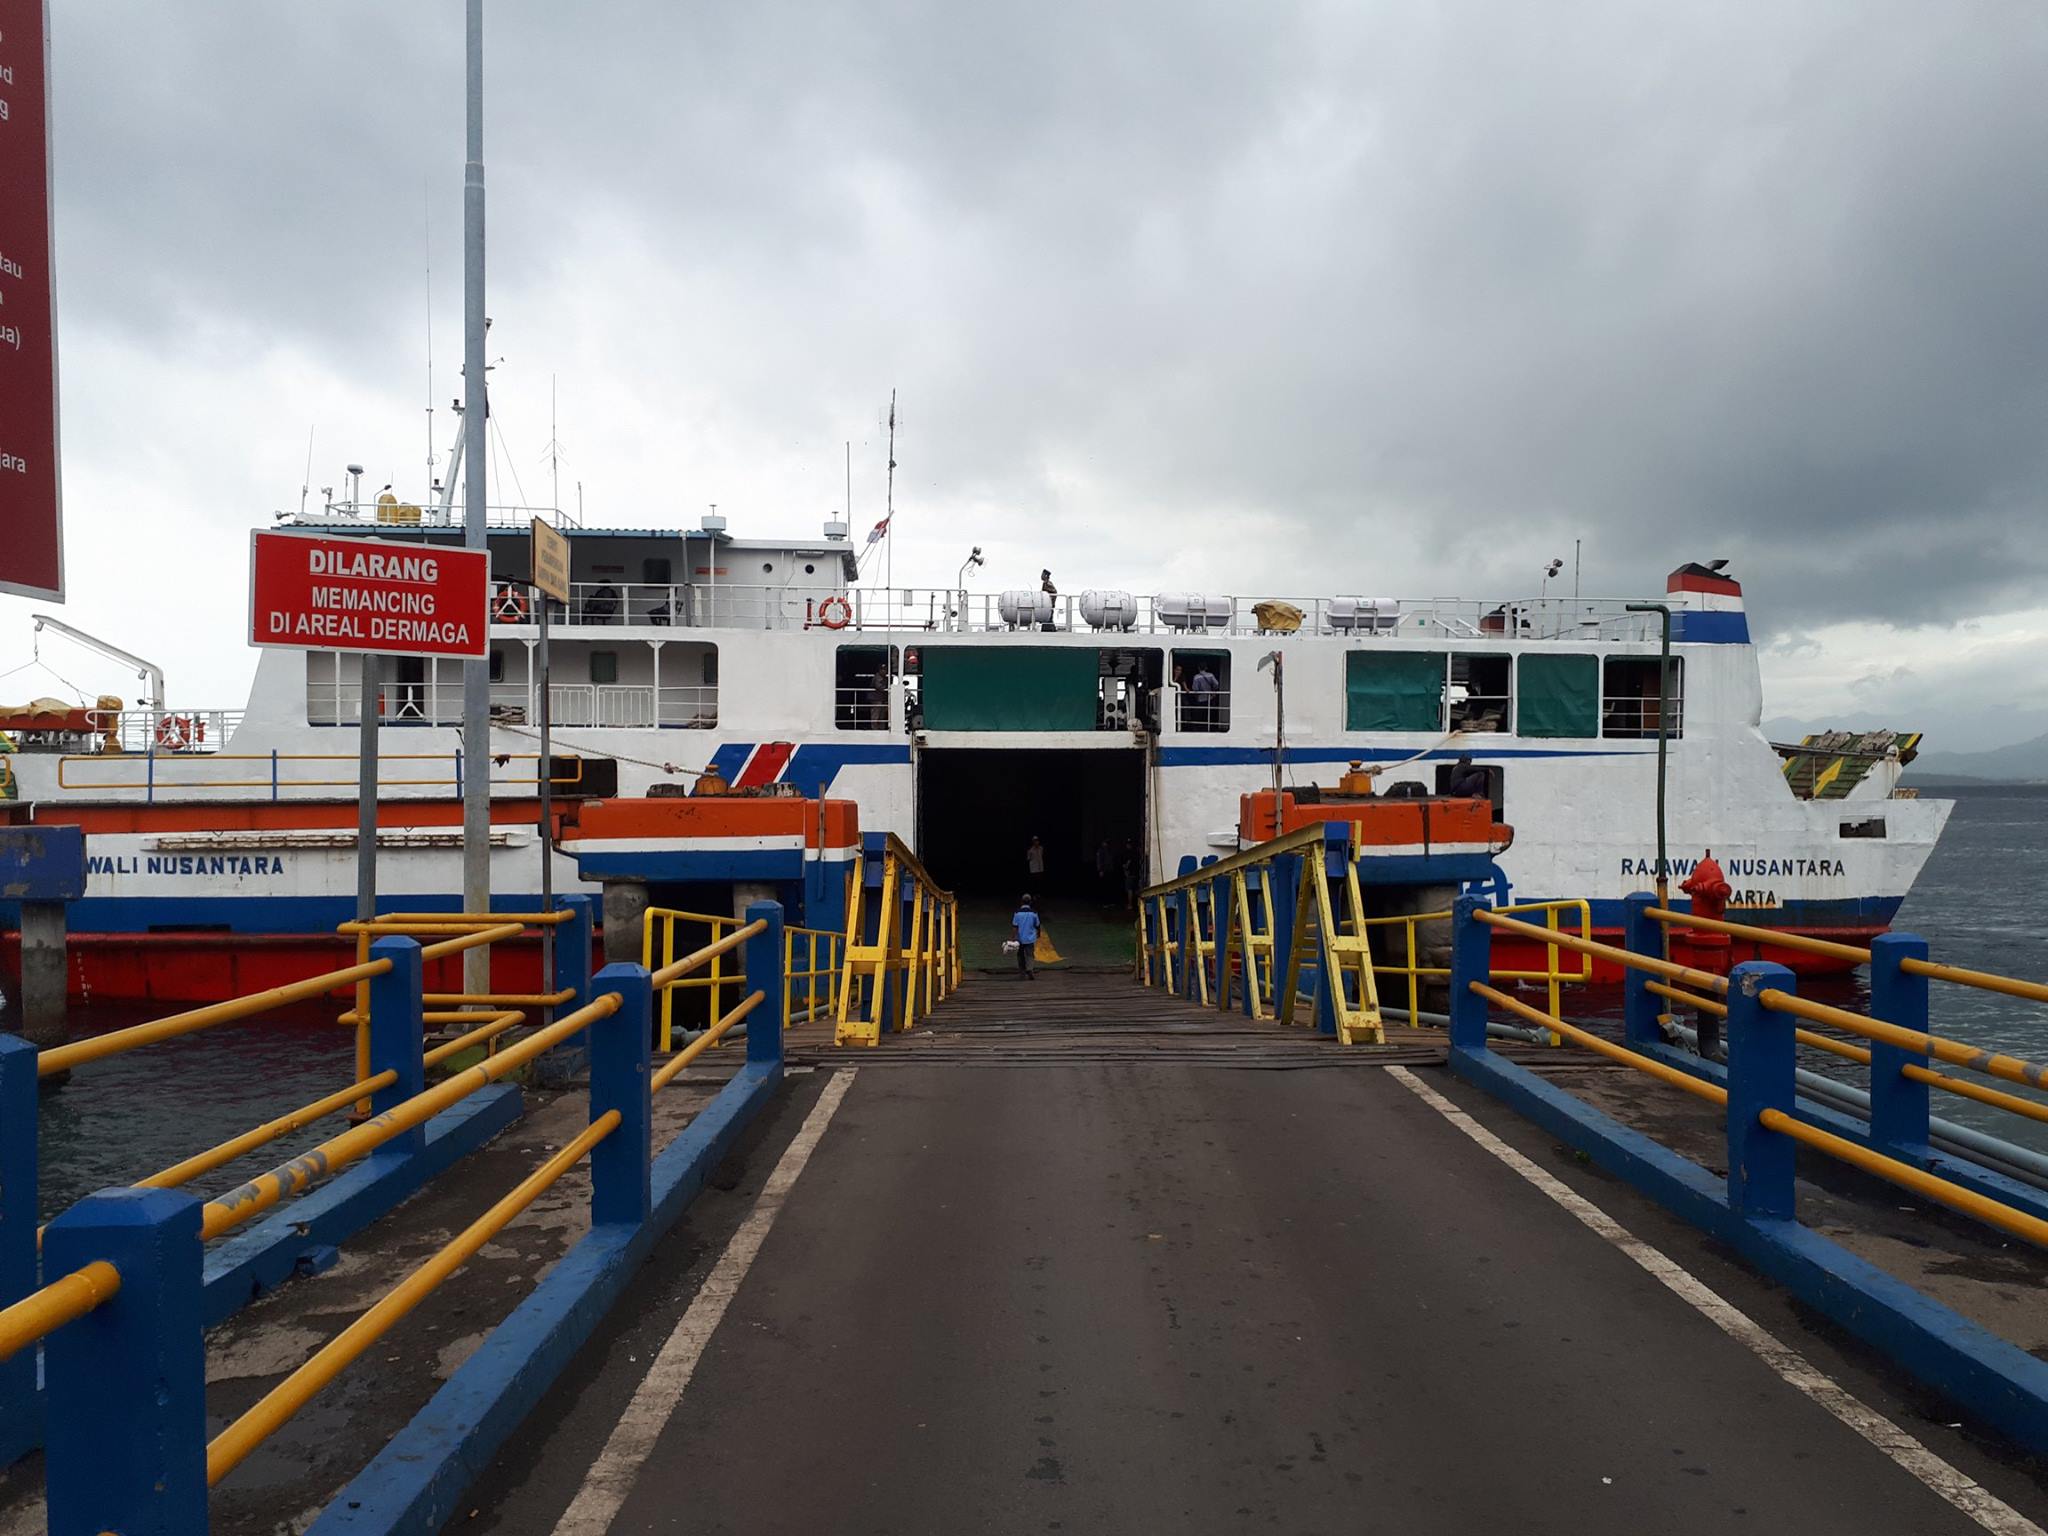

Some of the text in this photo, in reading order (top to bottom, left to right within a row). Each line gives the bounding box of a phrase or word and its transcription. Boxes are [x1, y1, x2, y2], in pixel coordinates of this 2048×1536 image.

[310, 549, 438, 582] DILARANG
[312, 586, 435, 615] MEMANCING
[270, 611, 470, 645] DI AREAL DERMAGA
[148, 856, 284, 875] NUSANTARA
[1729, 859, 1845, 876] NUSANTARA
